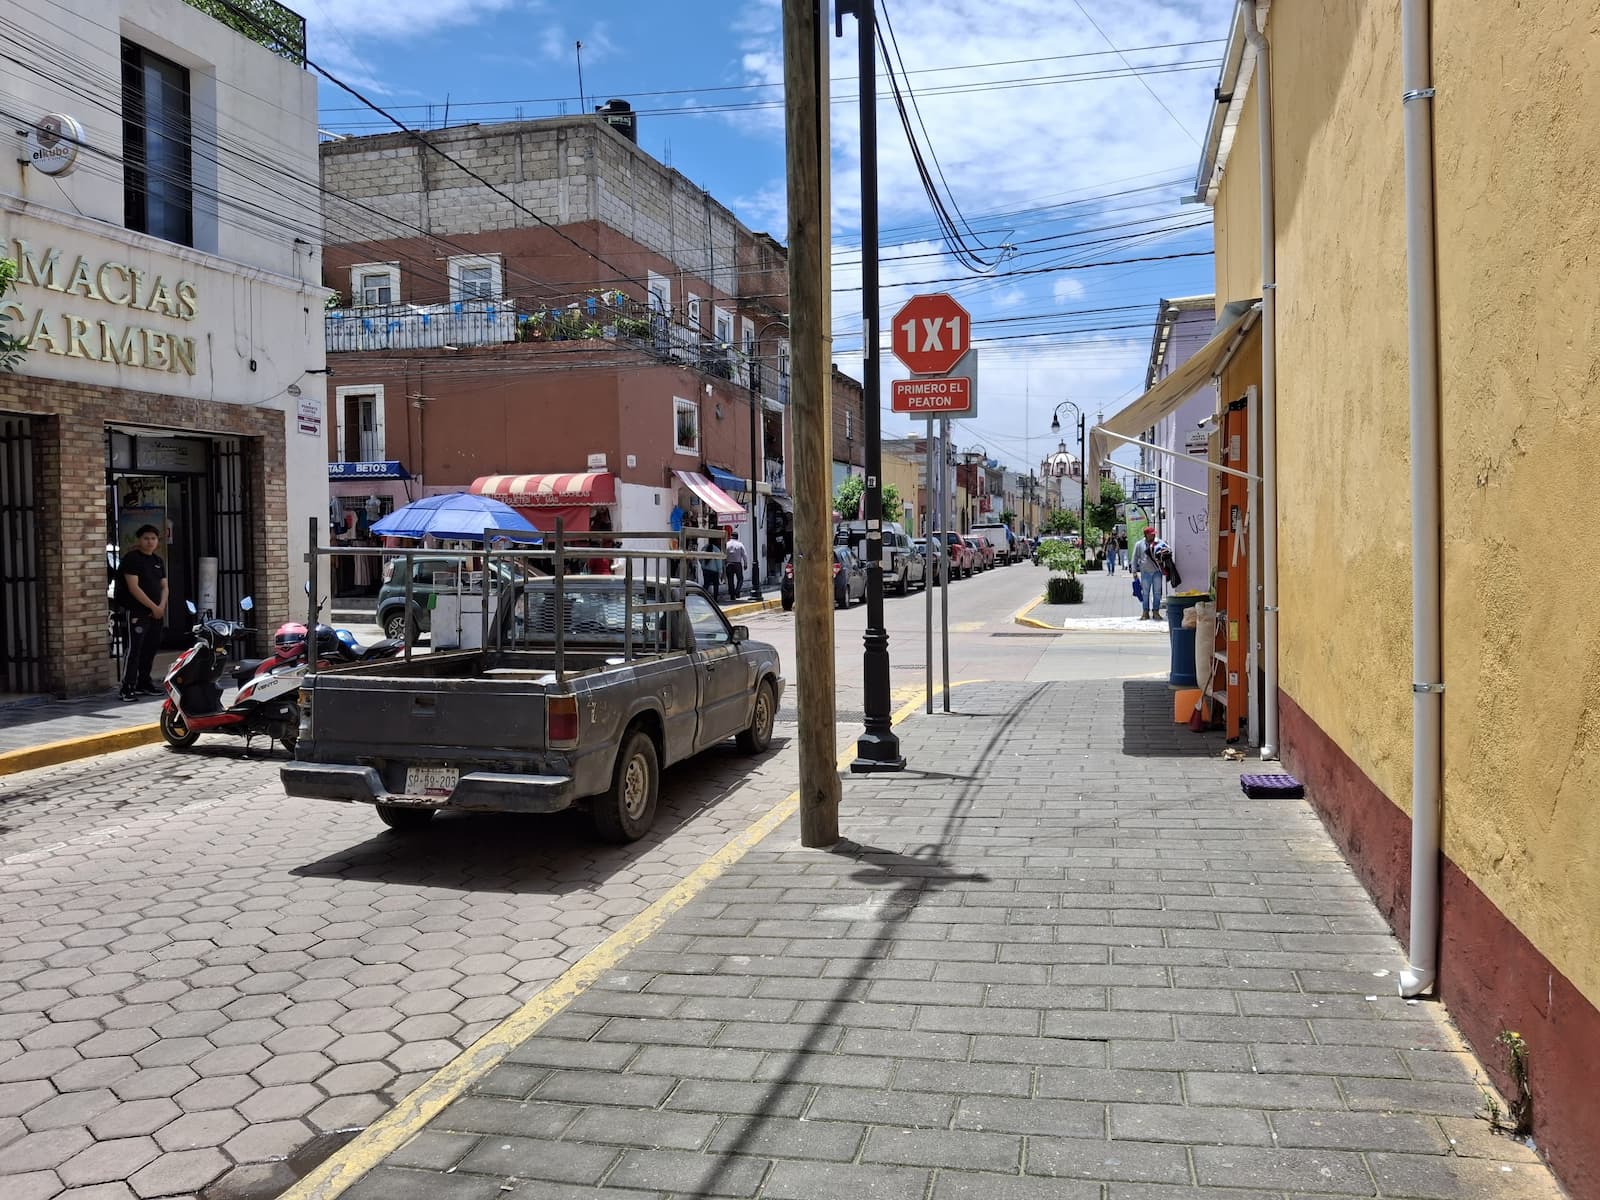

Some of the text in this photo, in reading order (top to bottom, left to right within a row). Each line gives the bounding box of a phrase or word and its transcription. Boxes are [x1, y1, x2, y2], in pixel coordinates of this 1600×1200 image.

[0, 238, 199, 321] MACIAS
[901, 316, 961, 353] 1X1
[897, 383, 964, 395] PRIMERO EL
[908, 397, 952, 408] PEATON
[355, 463, 387, 473] BETO'S
